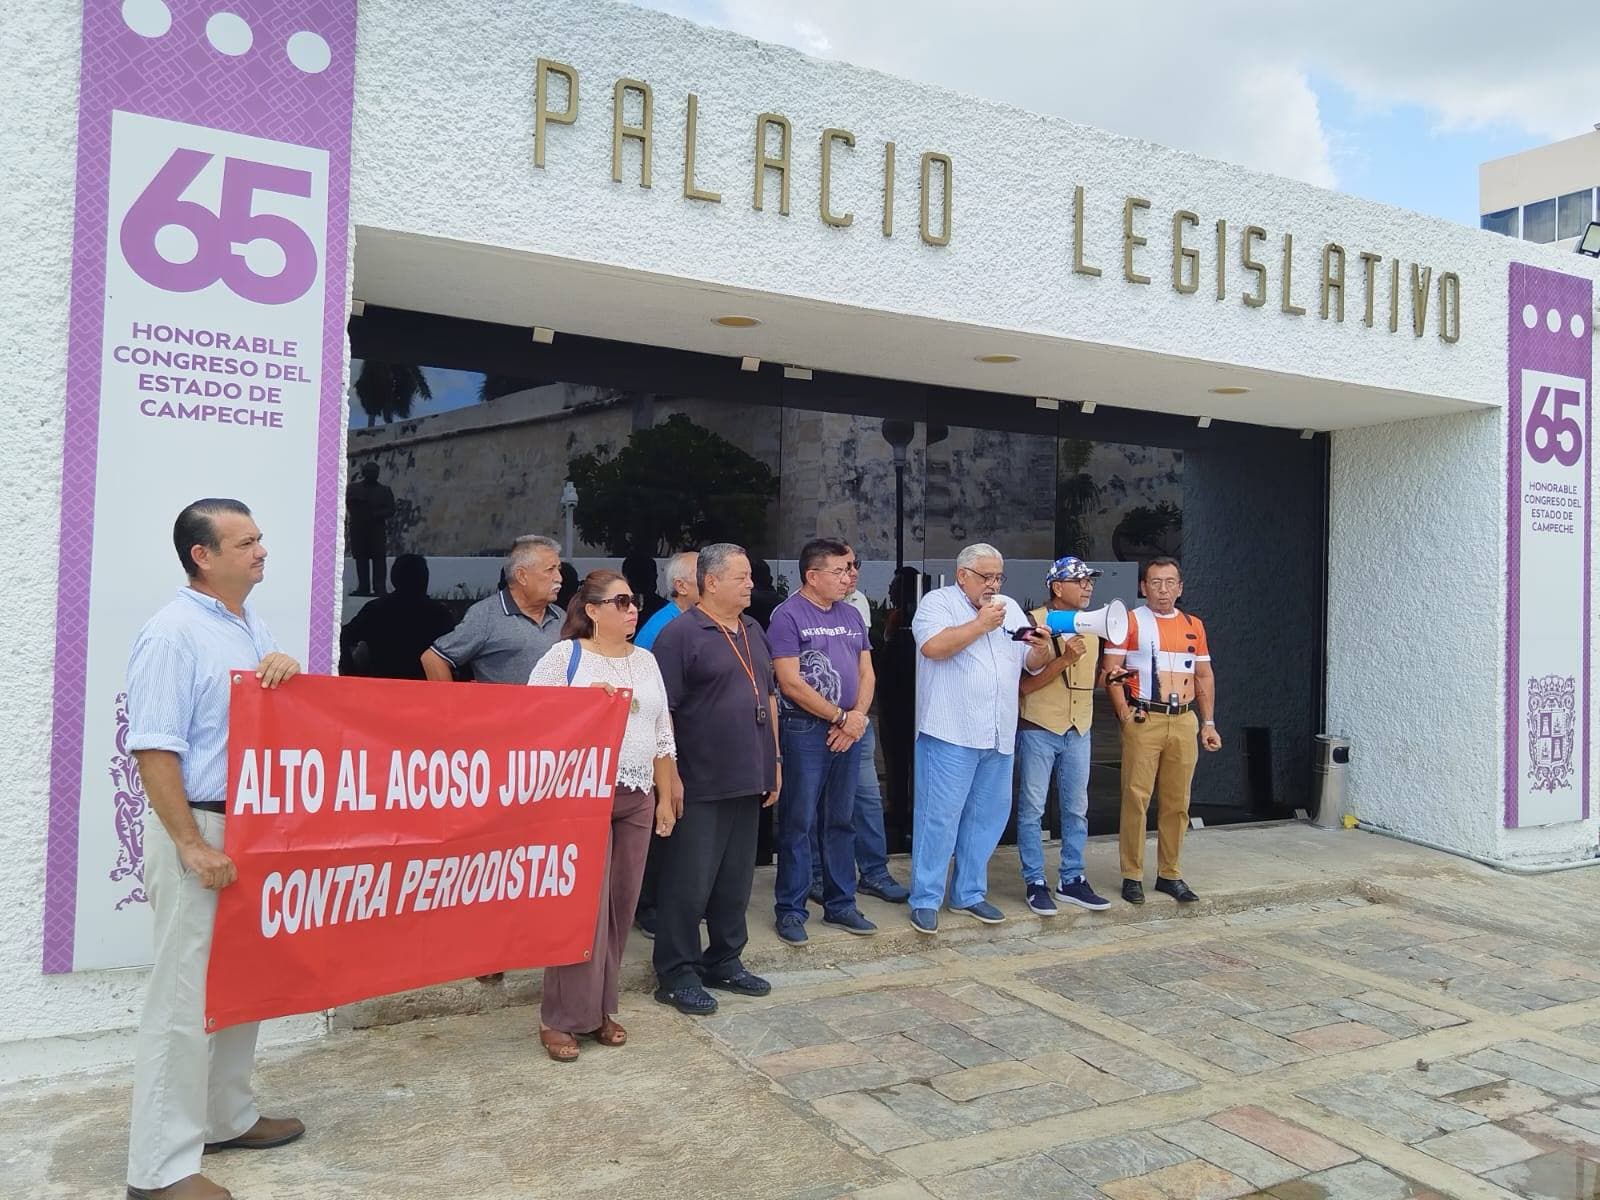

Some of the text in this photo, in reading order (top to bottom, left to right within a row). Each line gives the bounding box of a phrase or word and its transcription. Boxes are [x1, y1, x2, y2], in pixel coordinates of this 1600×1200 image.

[533, 57, 1462, 344] PALACIO LEGISLATIVO
[119, 146, 318, 305] 65
[132, 321, 298, 358] HONORABLE
[113, 345, 312, 384] CONGRESO DEL
[138, 373, 282, 404] ESTADO DE
[140, 399, 284, 429] CAMPECHE
[1525, 385, 1583, 467] 65
[1524, 494, 1582, 508] CONGRESO DEL
[1529, 481, 1578, 495] HONORABLE
[1531, 508, 1573, 521] ESTADO DE
[1531, 521, 1575, 534] CAMPECHE
[233, 746, 613, 816] ALTO AL ACOSO JUDICIAL
[260, 843, 579, 939] CONTRA PERIODISTAS
